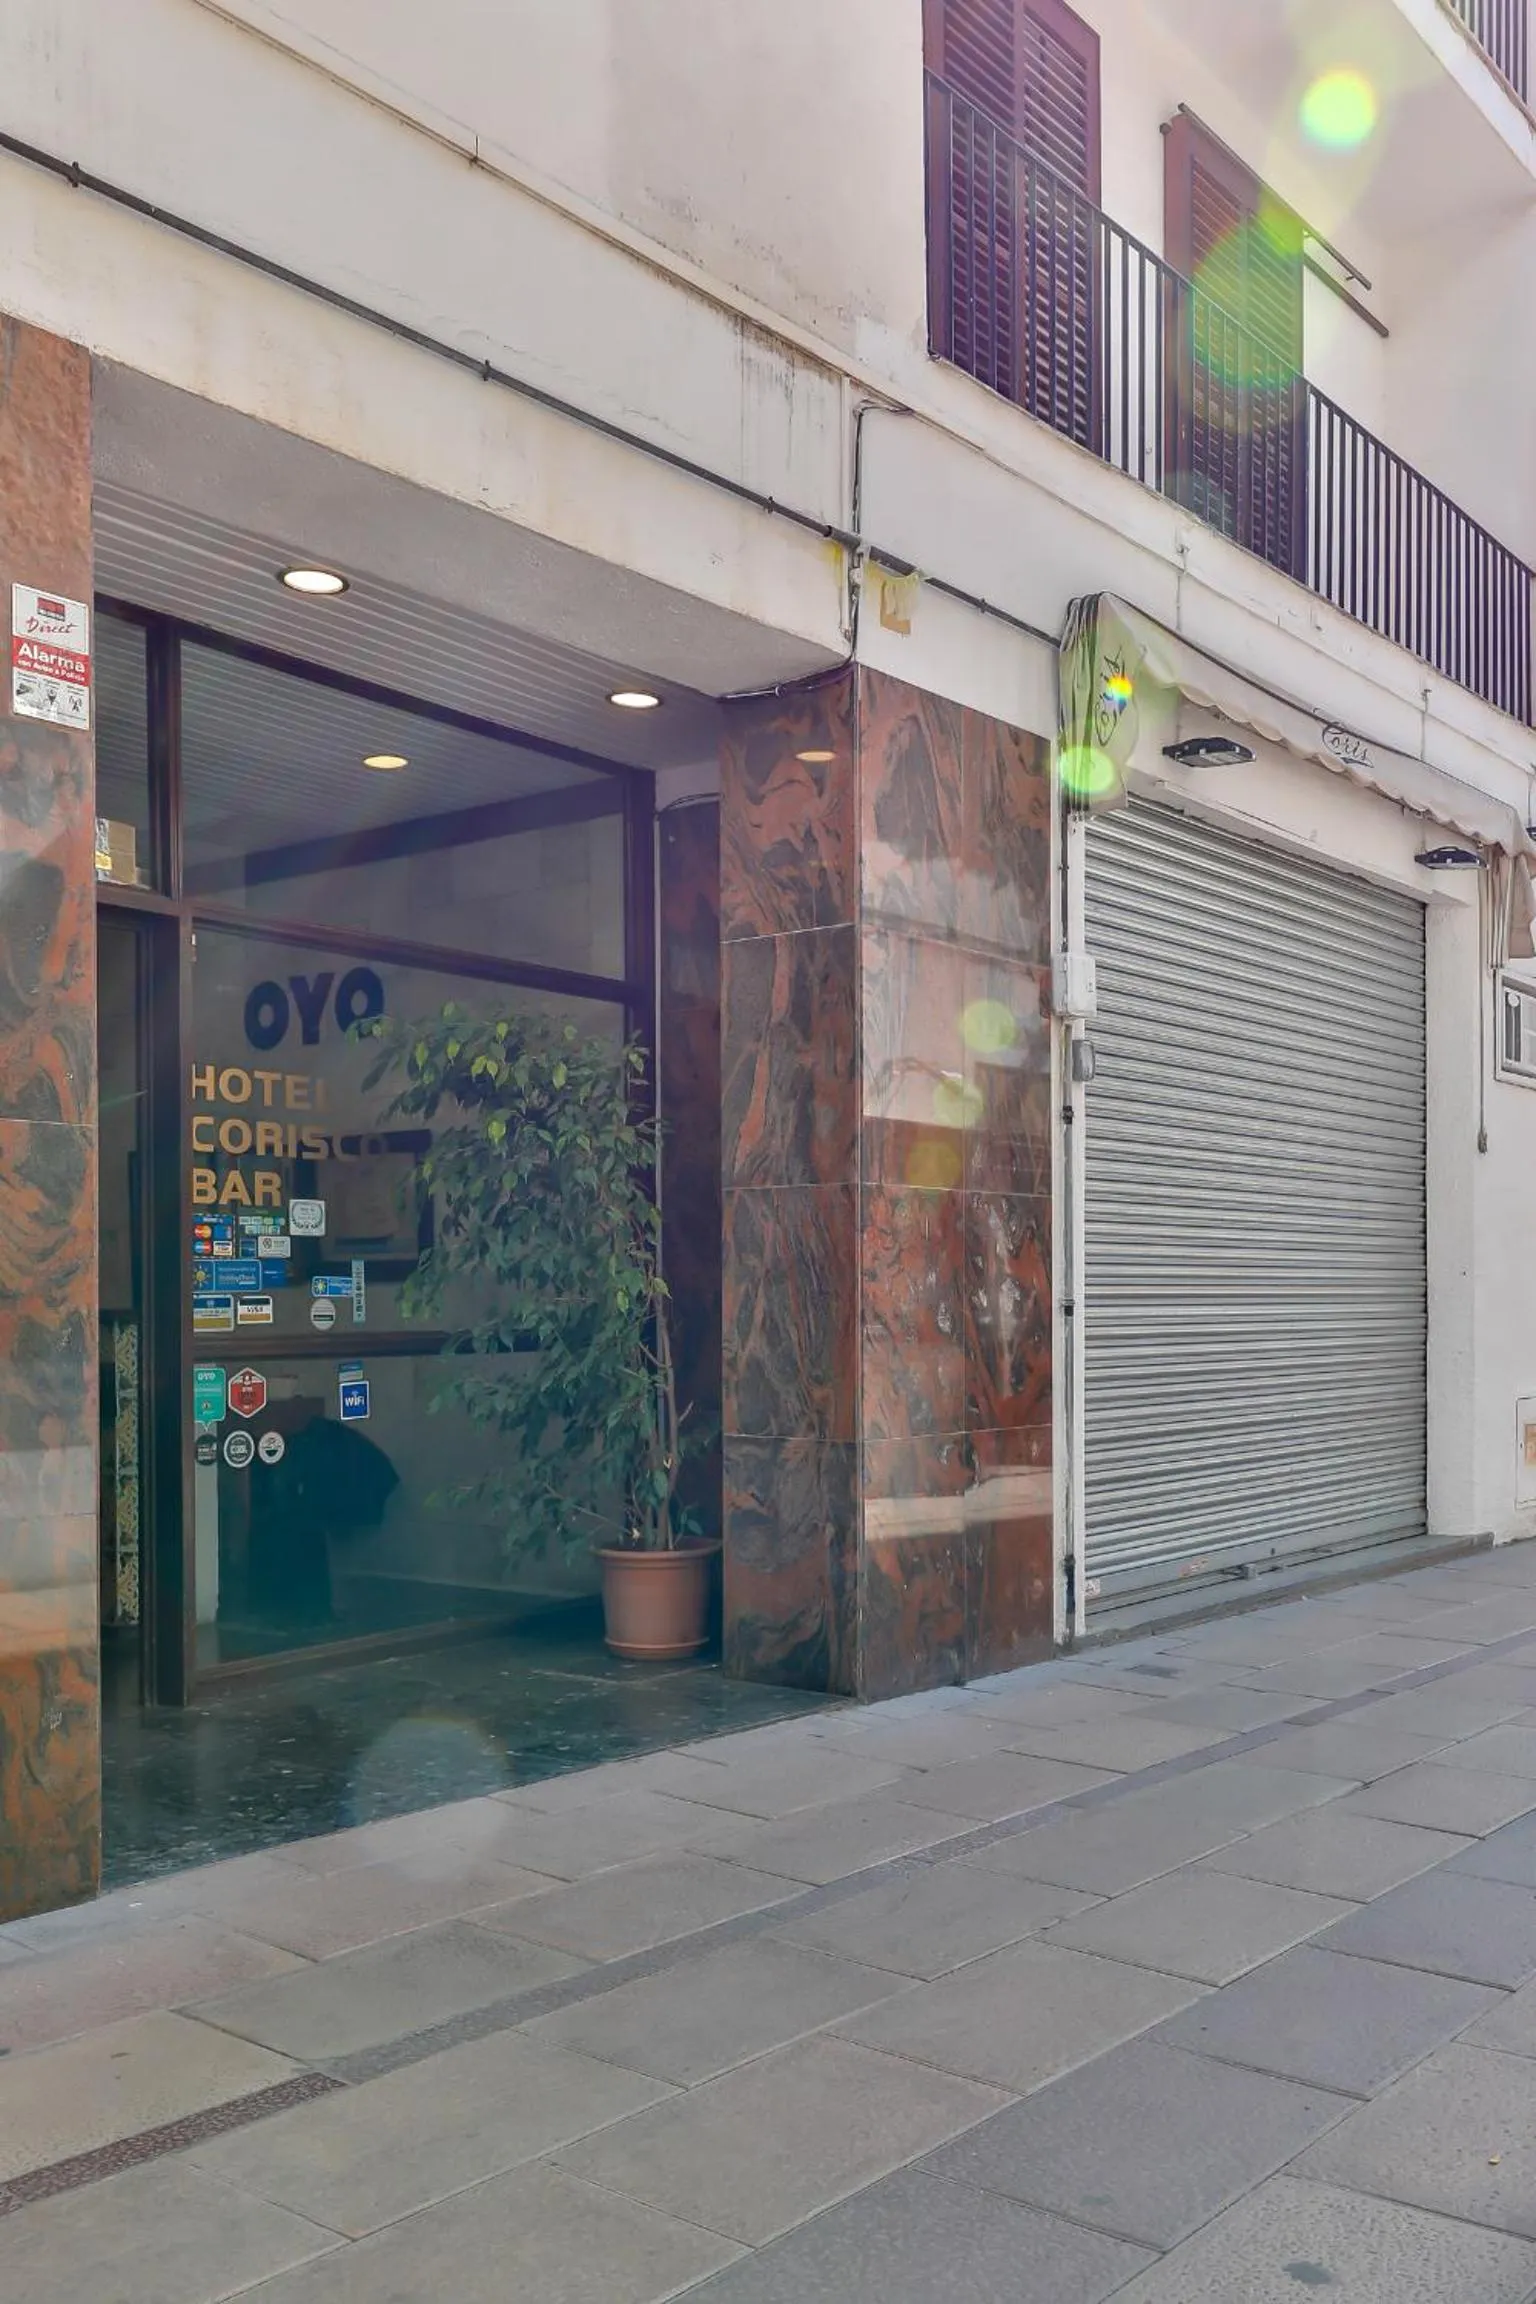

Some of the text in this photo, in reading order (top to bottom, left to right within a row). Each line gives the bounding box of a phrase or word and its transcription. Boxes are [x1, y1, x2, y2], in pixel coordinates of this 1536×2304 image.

[18, 642, 86, 674] Alarma
[244, 966, 385, 1051] OYO
[191, 1116, 387, 1162] CORISCO
[191, 1167, 282, 1206] BAR
